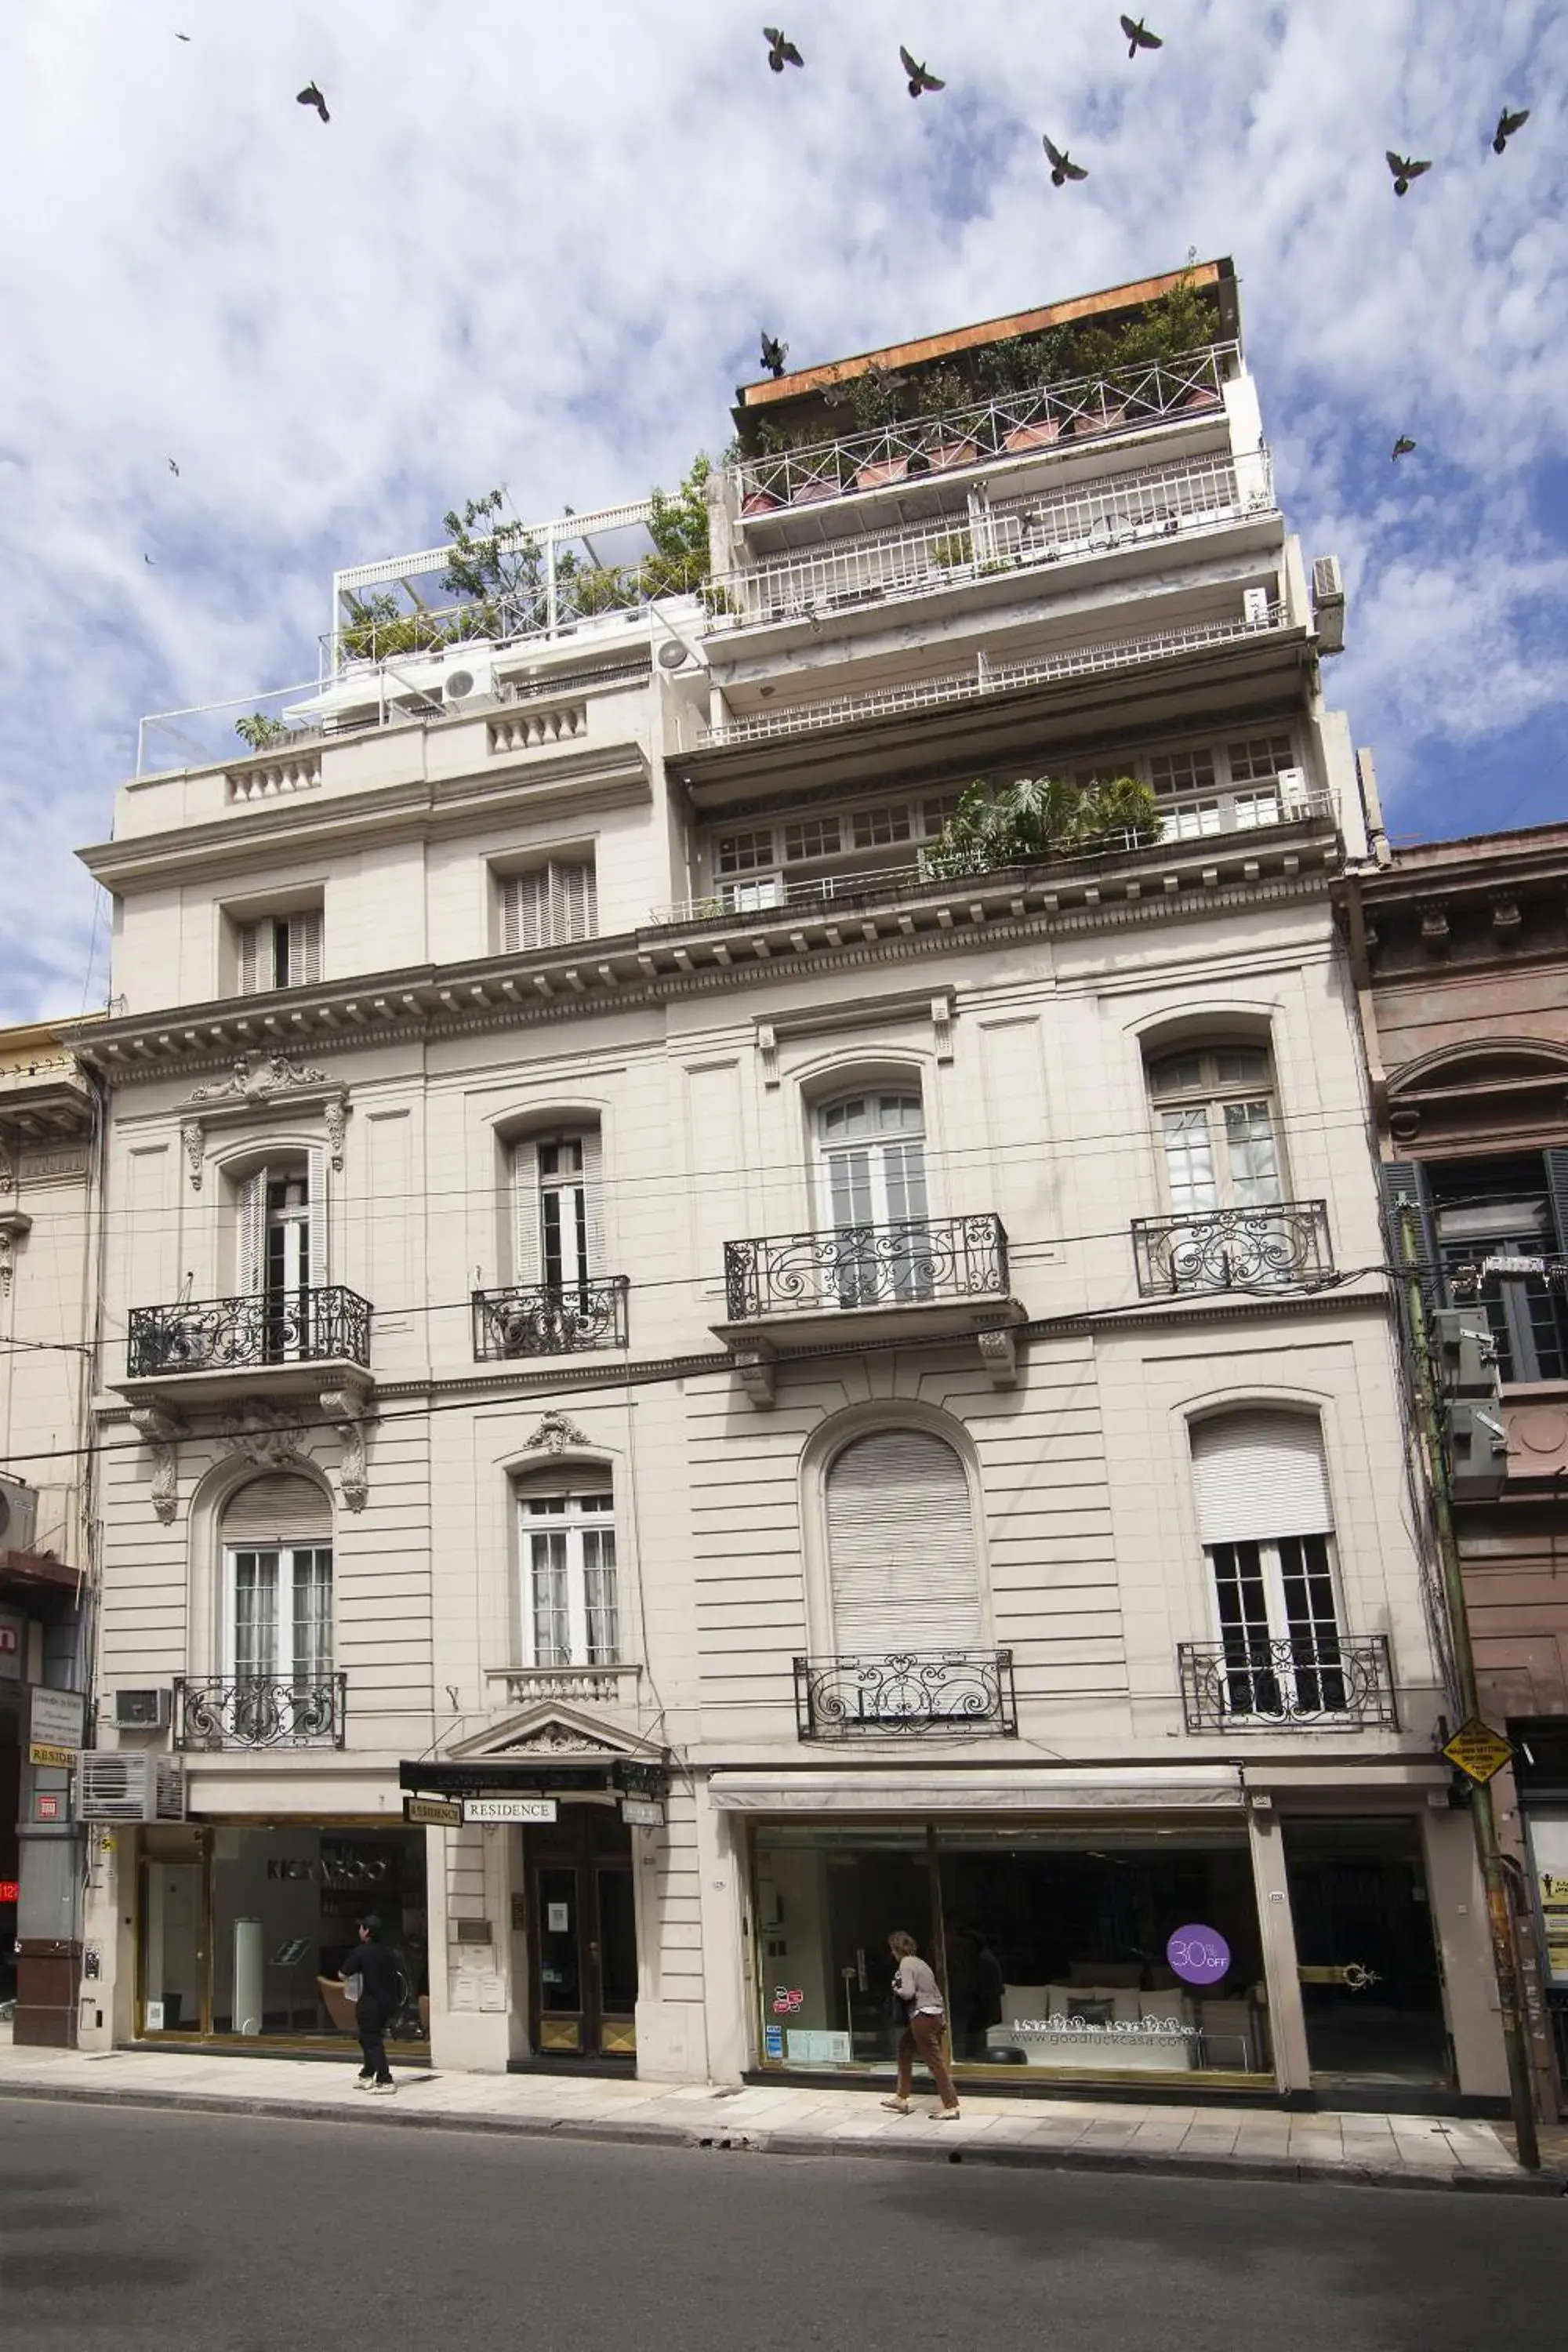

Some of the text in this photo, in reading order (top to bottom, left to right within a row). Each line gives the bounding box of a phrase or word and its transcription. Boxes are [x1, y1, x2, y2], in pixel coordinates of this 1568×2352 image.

[411, 1804, 458, 1820] RESIDENCE
[470, 1803, 550, 1817] RESIDENCE
[1207, 1957, 1229, 1967] OFF
